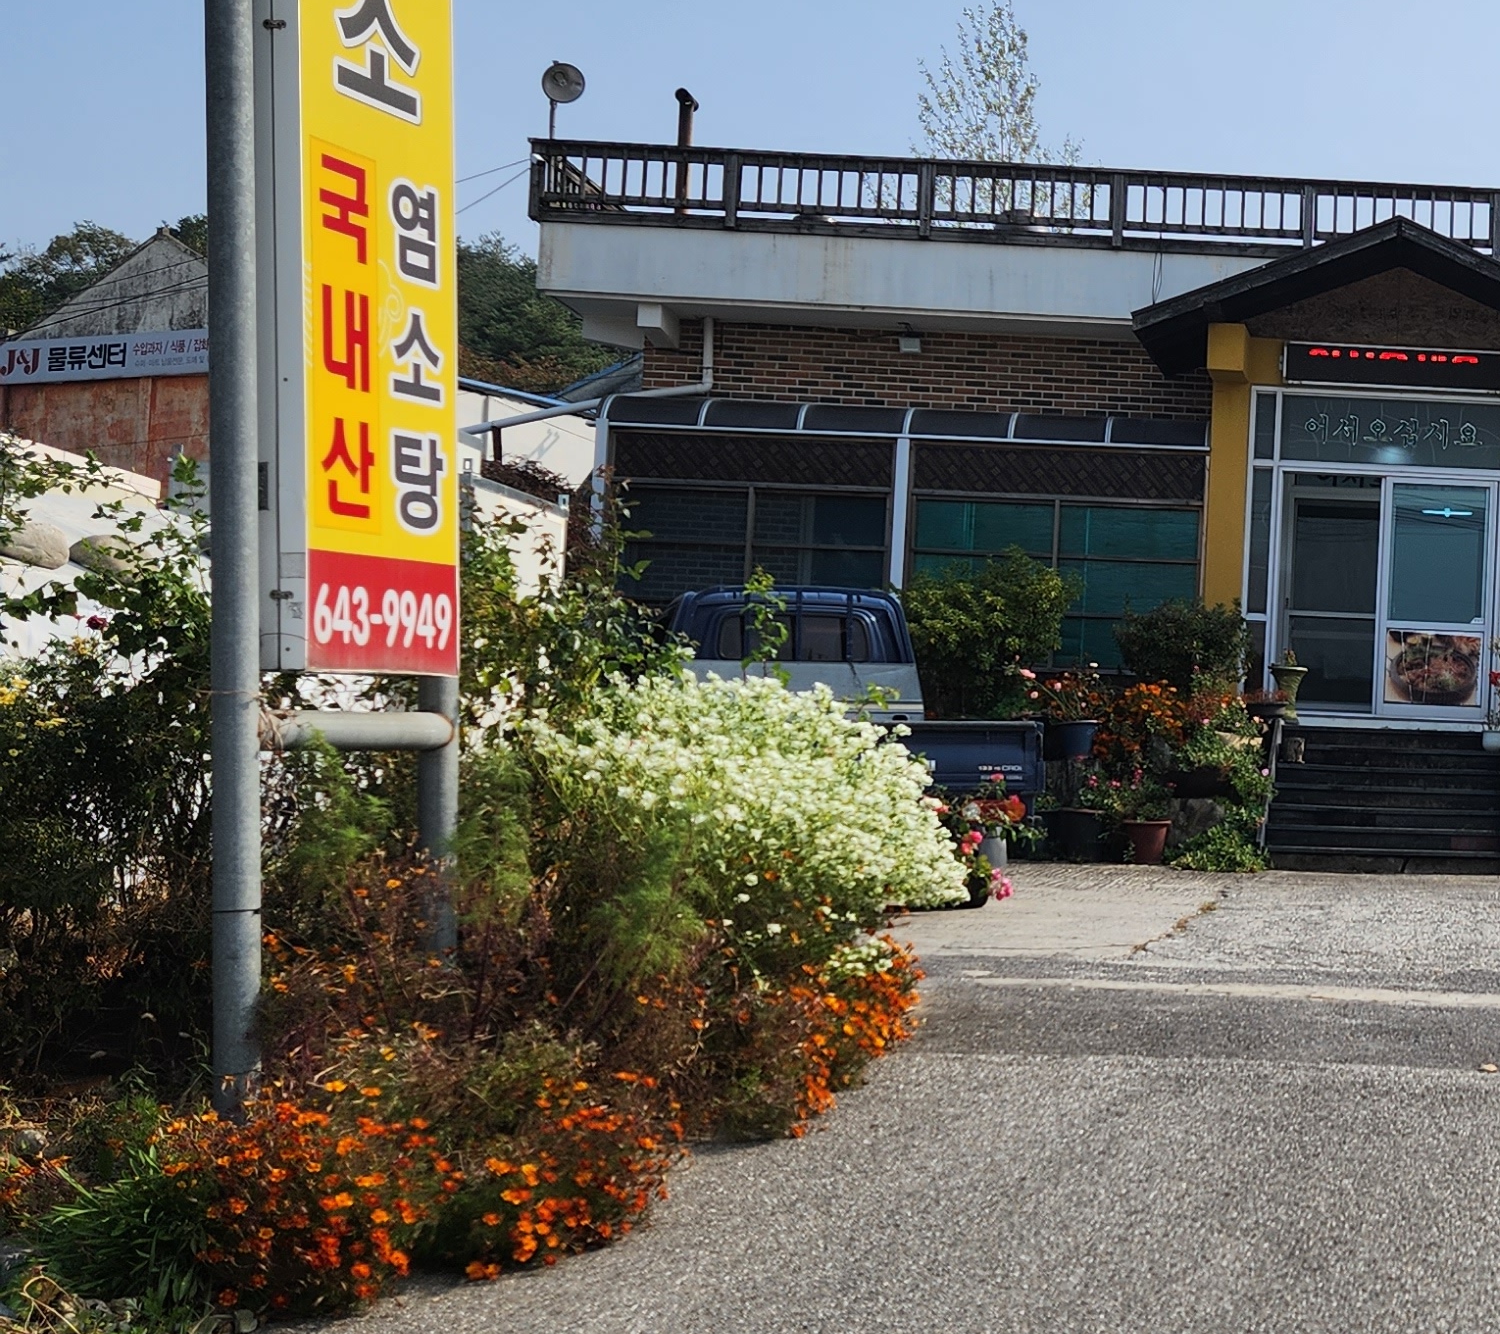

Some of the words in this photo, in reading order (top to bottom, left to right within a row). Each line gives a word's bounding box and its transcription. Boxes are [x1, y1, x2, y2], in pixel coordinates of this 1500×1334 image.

[0, 347, 42, 376] J&J
[47, 342, 127, 372] 물류센터
[318, 152, 375, 520] 국내산
[390, 178, 446, 535] 염소탕
[312, 582, 453, 651] 643-9949
